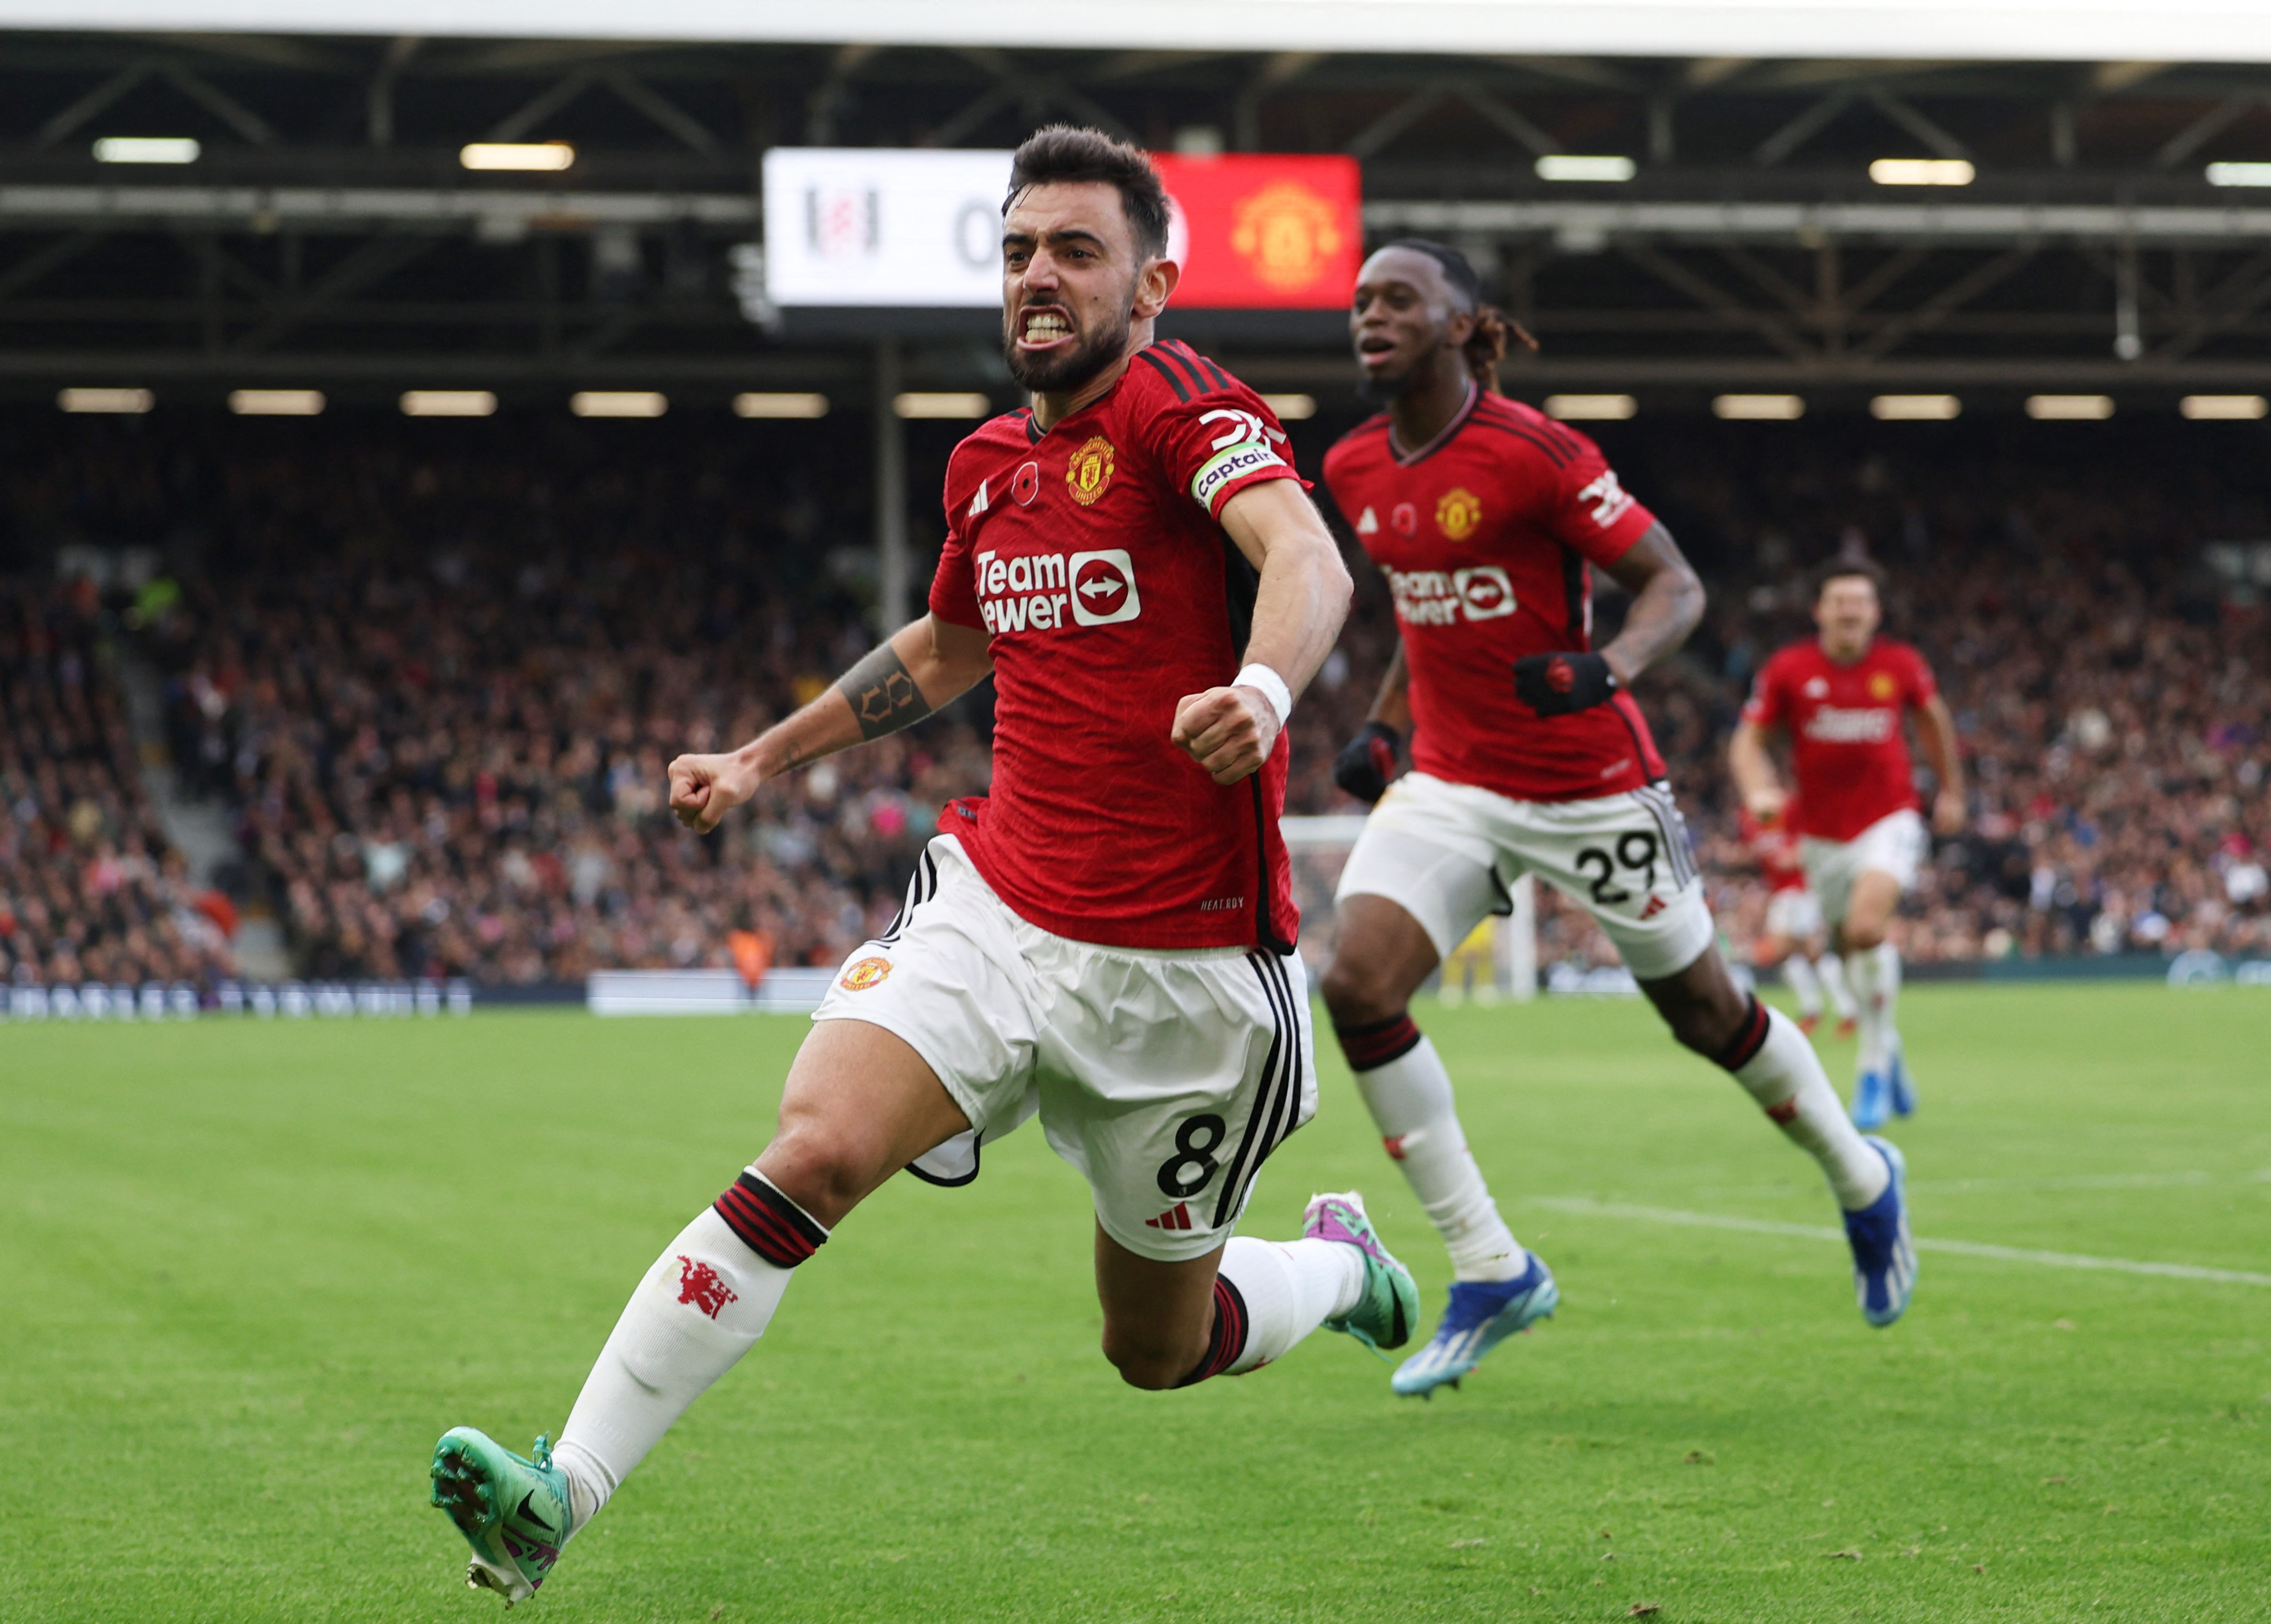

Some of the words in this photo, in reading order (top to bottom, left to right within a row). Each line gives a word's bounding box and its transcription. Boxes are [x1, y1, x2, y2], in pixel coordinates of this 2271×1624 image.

[955, 197, 1002, 272] 0
[1076, 486, 1103, 501] UNITED
[977, 550, 1066, 596] Team
[1574, 830, 1657, 904] 29
[1200, 896, 1244, 911] HEAT.RDY
[1157, 1113, 1226, 1198] 8
